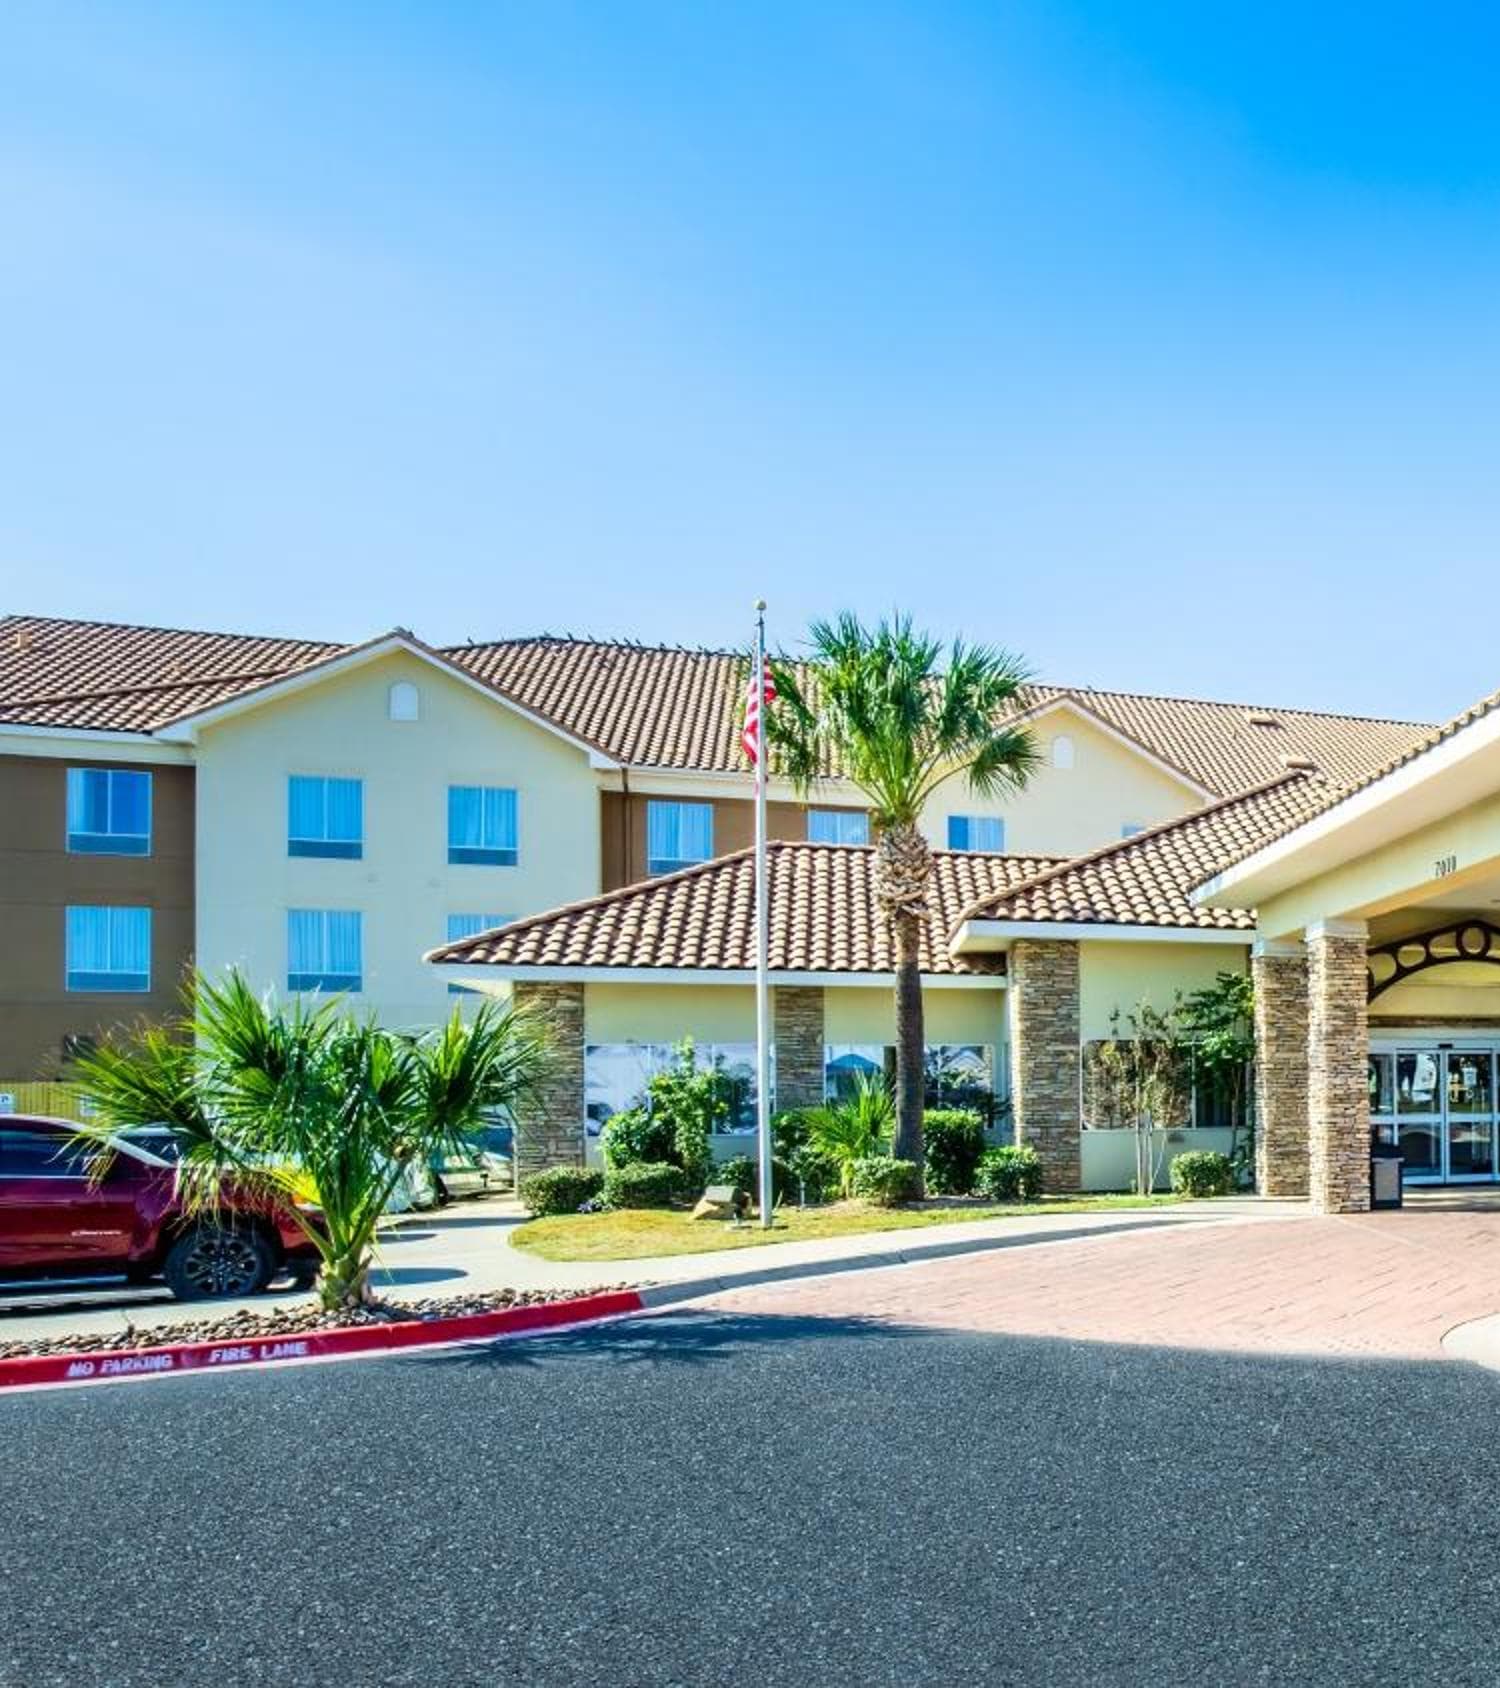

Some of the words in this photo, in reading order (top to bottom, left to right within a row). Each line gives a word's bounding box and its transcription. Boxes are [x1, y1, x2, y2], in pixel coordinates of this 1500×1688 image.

[67, 1361, 95, 1378] NO
[100, 1354, 174, 1376] PARKING
[209, 1345, 254, 1364] FIRE
[260, 1341, 309, 1358] LANE
